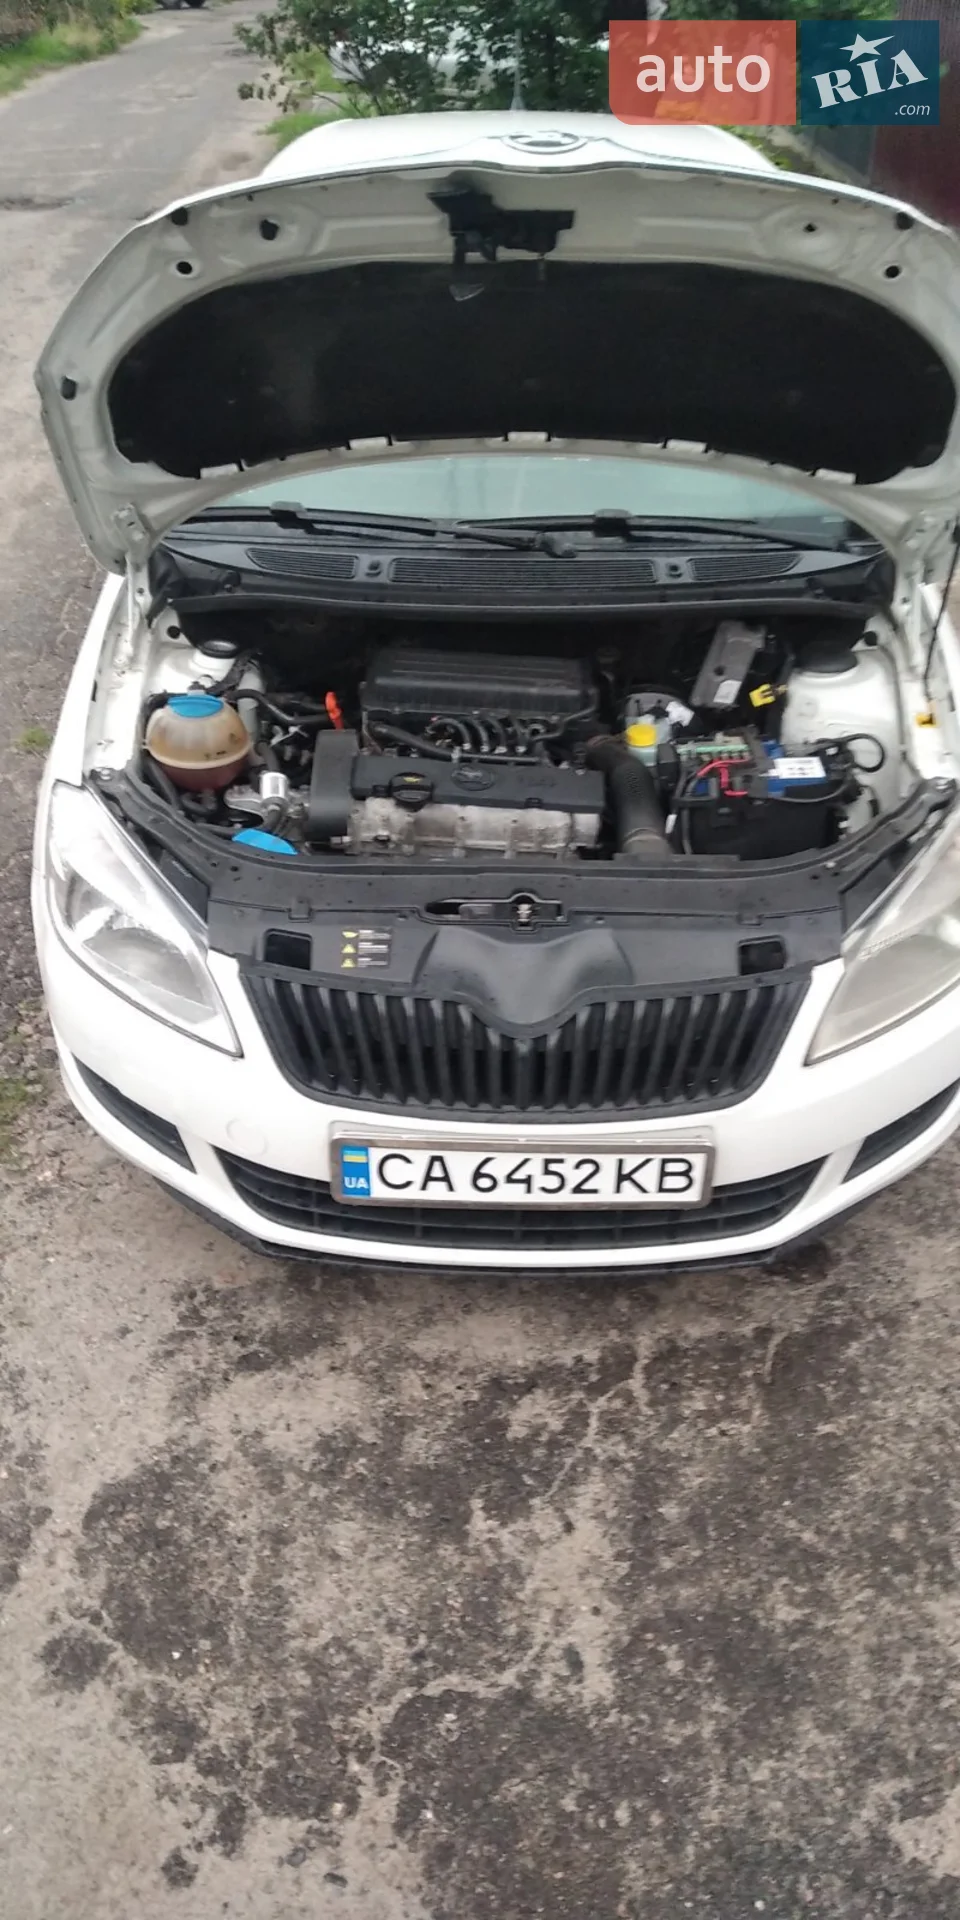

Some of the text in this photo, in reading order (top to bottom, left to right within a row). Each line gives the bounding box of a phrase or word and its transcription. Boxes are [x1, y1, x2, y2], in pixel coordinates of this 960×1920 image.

[344, 1176, 369, 1189] UA
[377, 1153, 694, 1194] CA 6452 KB
